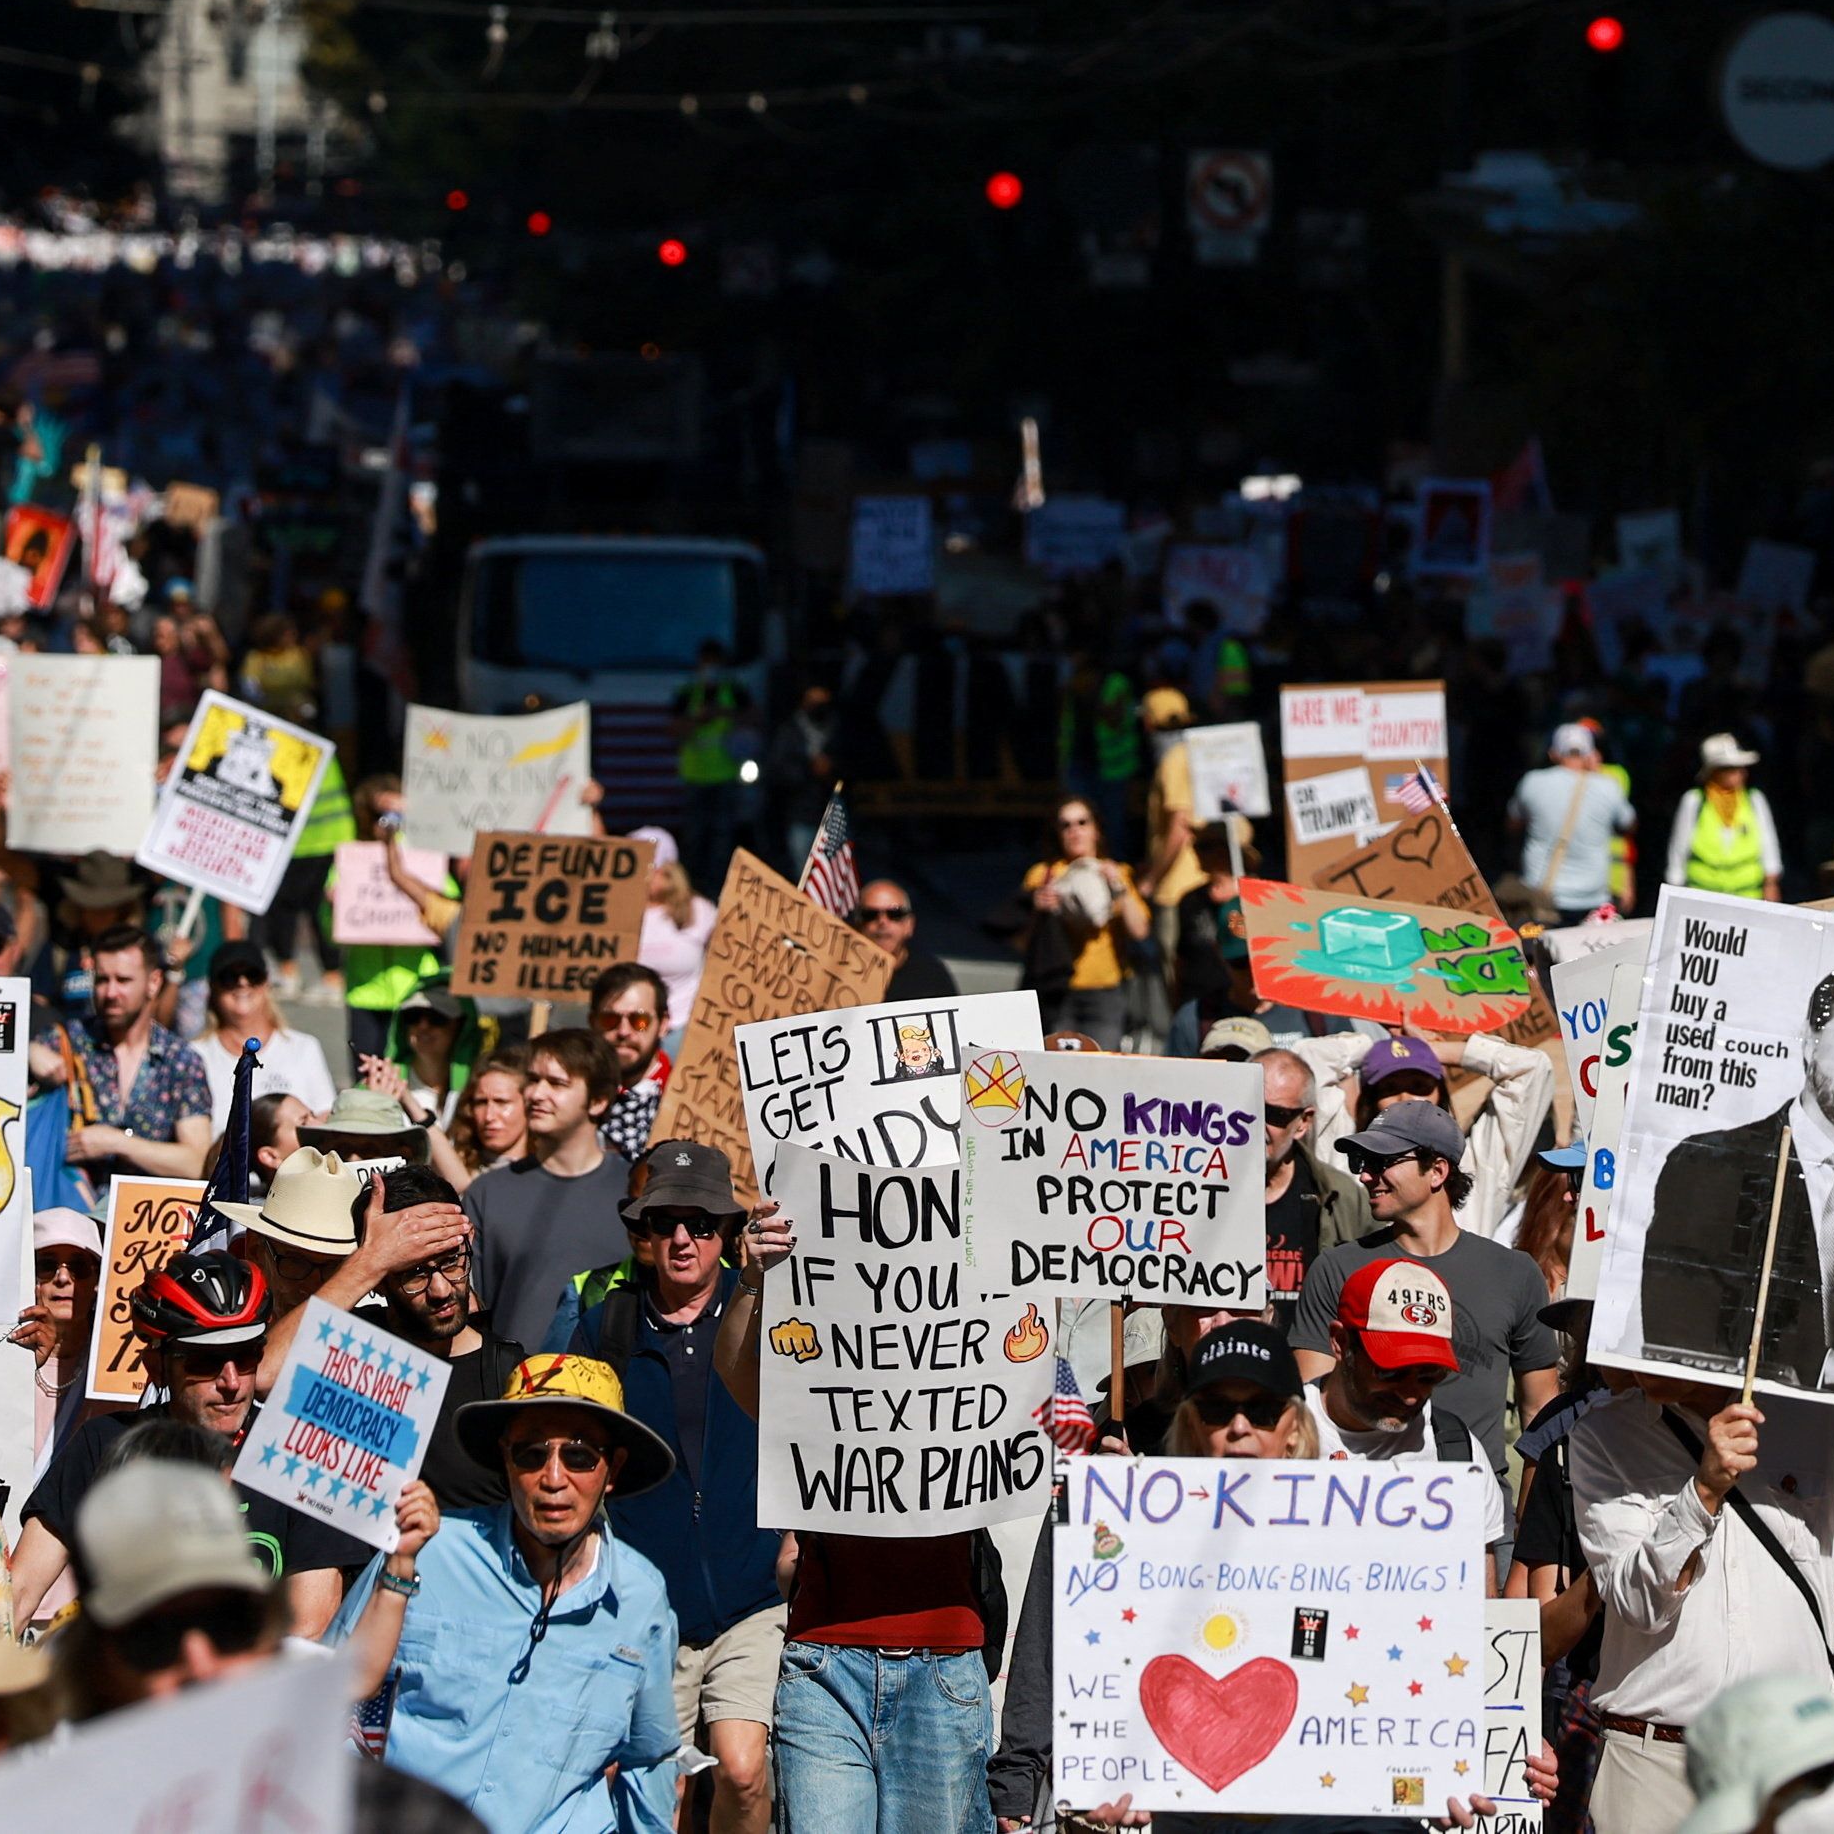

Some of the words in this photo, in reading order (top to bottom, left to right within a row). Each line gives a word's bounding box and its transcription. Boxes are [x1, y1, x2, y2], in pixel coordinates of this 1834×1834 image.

[1289, 697, 1324, 727] ARE
[1333, 697, 1362, 725] WE
[1370, 719, 1442, 749] COUNTRY
[486, 841, 638, 880] DEFUND
[487, 880, 611, 924] ICE
[471, 931, 509, 954] NO
[519, 932, 620, 959] HUMAN
[735, 864, 889, 986] PATRIOTISM
[1683, 918, 1748, 958] Would
[469, 959, 499, 984] IS
[518, 963, 604, 991] ILLEG
[716, 932, 794, 1000] STAND
[722, 901, 820, 986] MEANS
[823, 969, 862, 1009] TO
[1679, 951, 1718, 987] YOU
[697, 997, 733, 1036] IT
[1670, 986, 1709, 1021] buy
[1714, 1000, 1727, 1023] a
[740, 1025, 851, 1091] LETS
[1666, 1020, 1715, 1052] used
[1725, 1038, 1789, 1060] couch
[1663, 1047, 1714, 1083] from
[1719, 1059, 1758, 1090] this
[760, 1075, 845, 1140] GET
[1024, 1083, 1106, 1131] NO
[1123, 1093, 1257, 1146] KINGS
[1655, 1080, 1716, 1113] man?
[965, 1136, 976, 1206] EPSTEIN
[1001, 1126, 1046, 1162] IN
[1060, 1132, 1229, 1180] AMERICA
[819, 1162, 960, 1250] HON
[1037, 1176, 1230, 1219] PROTECT
[1087, 1216, 1192, 1254] OUR
[789, 1255, 835, 1307] IF
[1011, 1239, 1263, 1301] DEMOCRACY
[1387, 1289, 1447, 1312] 49ERS
[831, 1318, 990, 1371] NEVER
[320, 1346, 359, 1389] THIS
[352, 1363, 374, 1397] IS
[369, 1368, 413, 1415] WHAT
[302, 1381, 400, 1453] DEMOCRACY
[810, 1383, 1007, 1433] TEXTED
[283, 1417, 347, 1471] LOOKS
[341, 1443, 390, 1492] LIKE
[790, 1440, 908, 1514] WAR
[920, 1430, 1045, 1511] PLANS
[305, 1496, 316, 1507] NO
[315, 1501, 334, 1516] KINGS
[1082, 1465, 1184, 1527] NO
[1212, 1469, 1455, 1532] KINGS
[1068, 1674, 1122, 1702] WE
[1069, 1719, 1129, 1739] THE
[1299, 1715, 1477, 1749] AMERICA
[1061, 1757, 1180, 1784] PEOPLE
